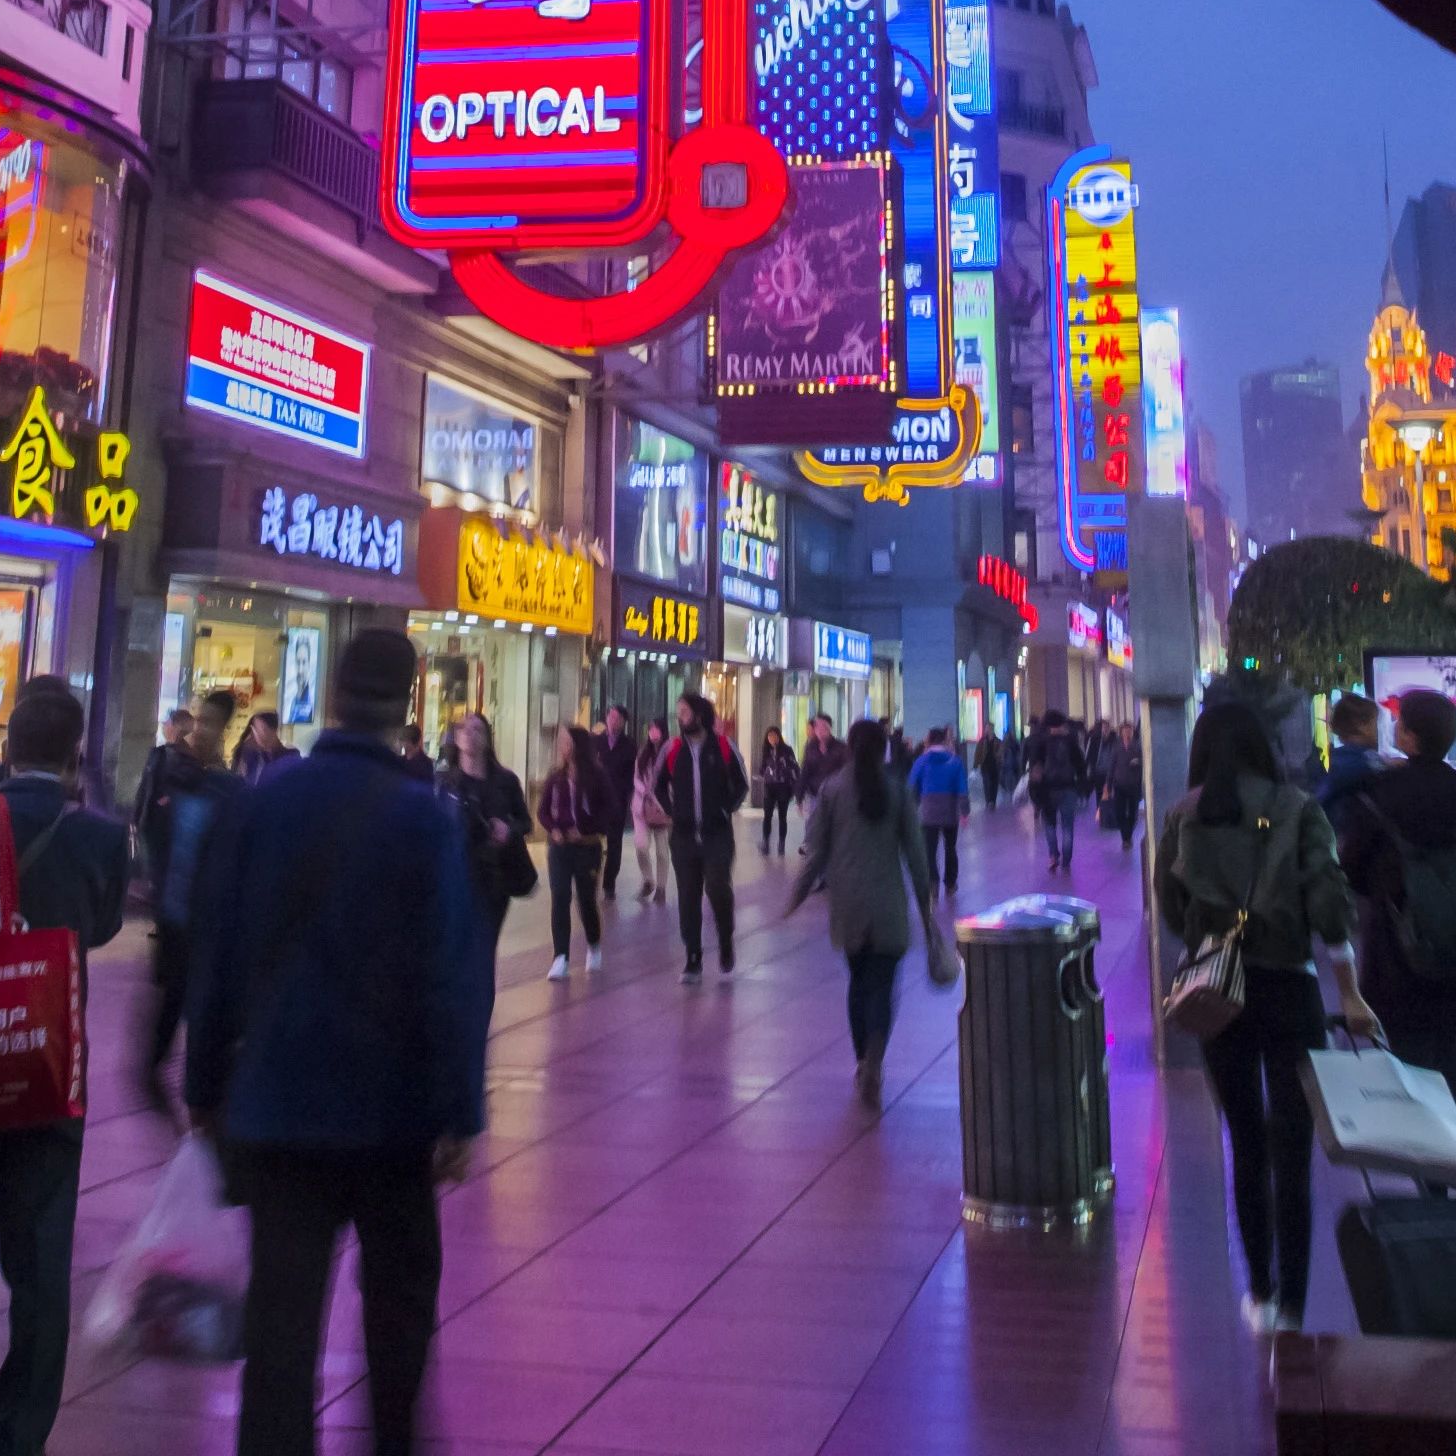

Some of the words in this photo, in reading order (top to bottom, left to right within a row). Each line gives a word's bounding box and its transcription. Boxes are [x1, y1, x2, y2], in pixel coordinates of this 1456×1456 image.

[419, 84, 621, 142] OPTICAL
[790, 350, 874, 380] MARTIN
[275, 398, 297, 427] TAX
[299, 406, 326, 435] FREE
[823, 443, 939, 463] MENSWEAR
[260, 485, 404, 576] 茂昌眼镜公司
